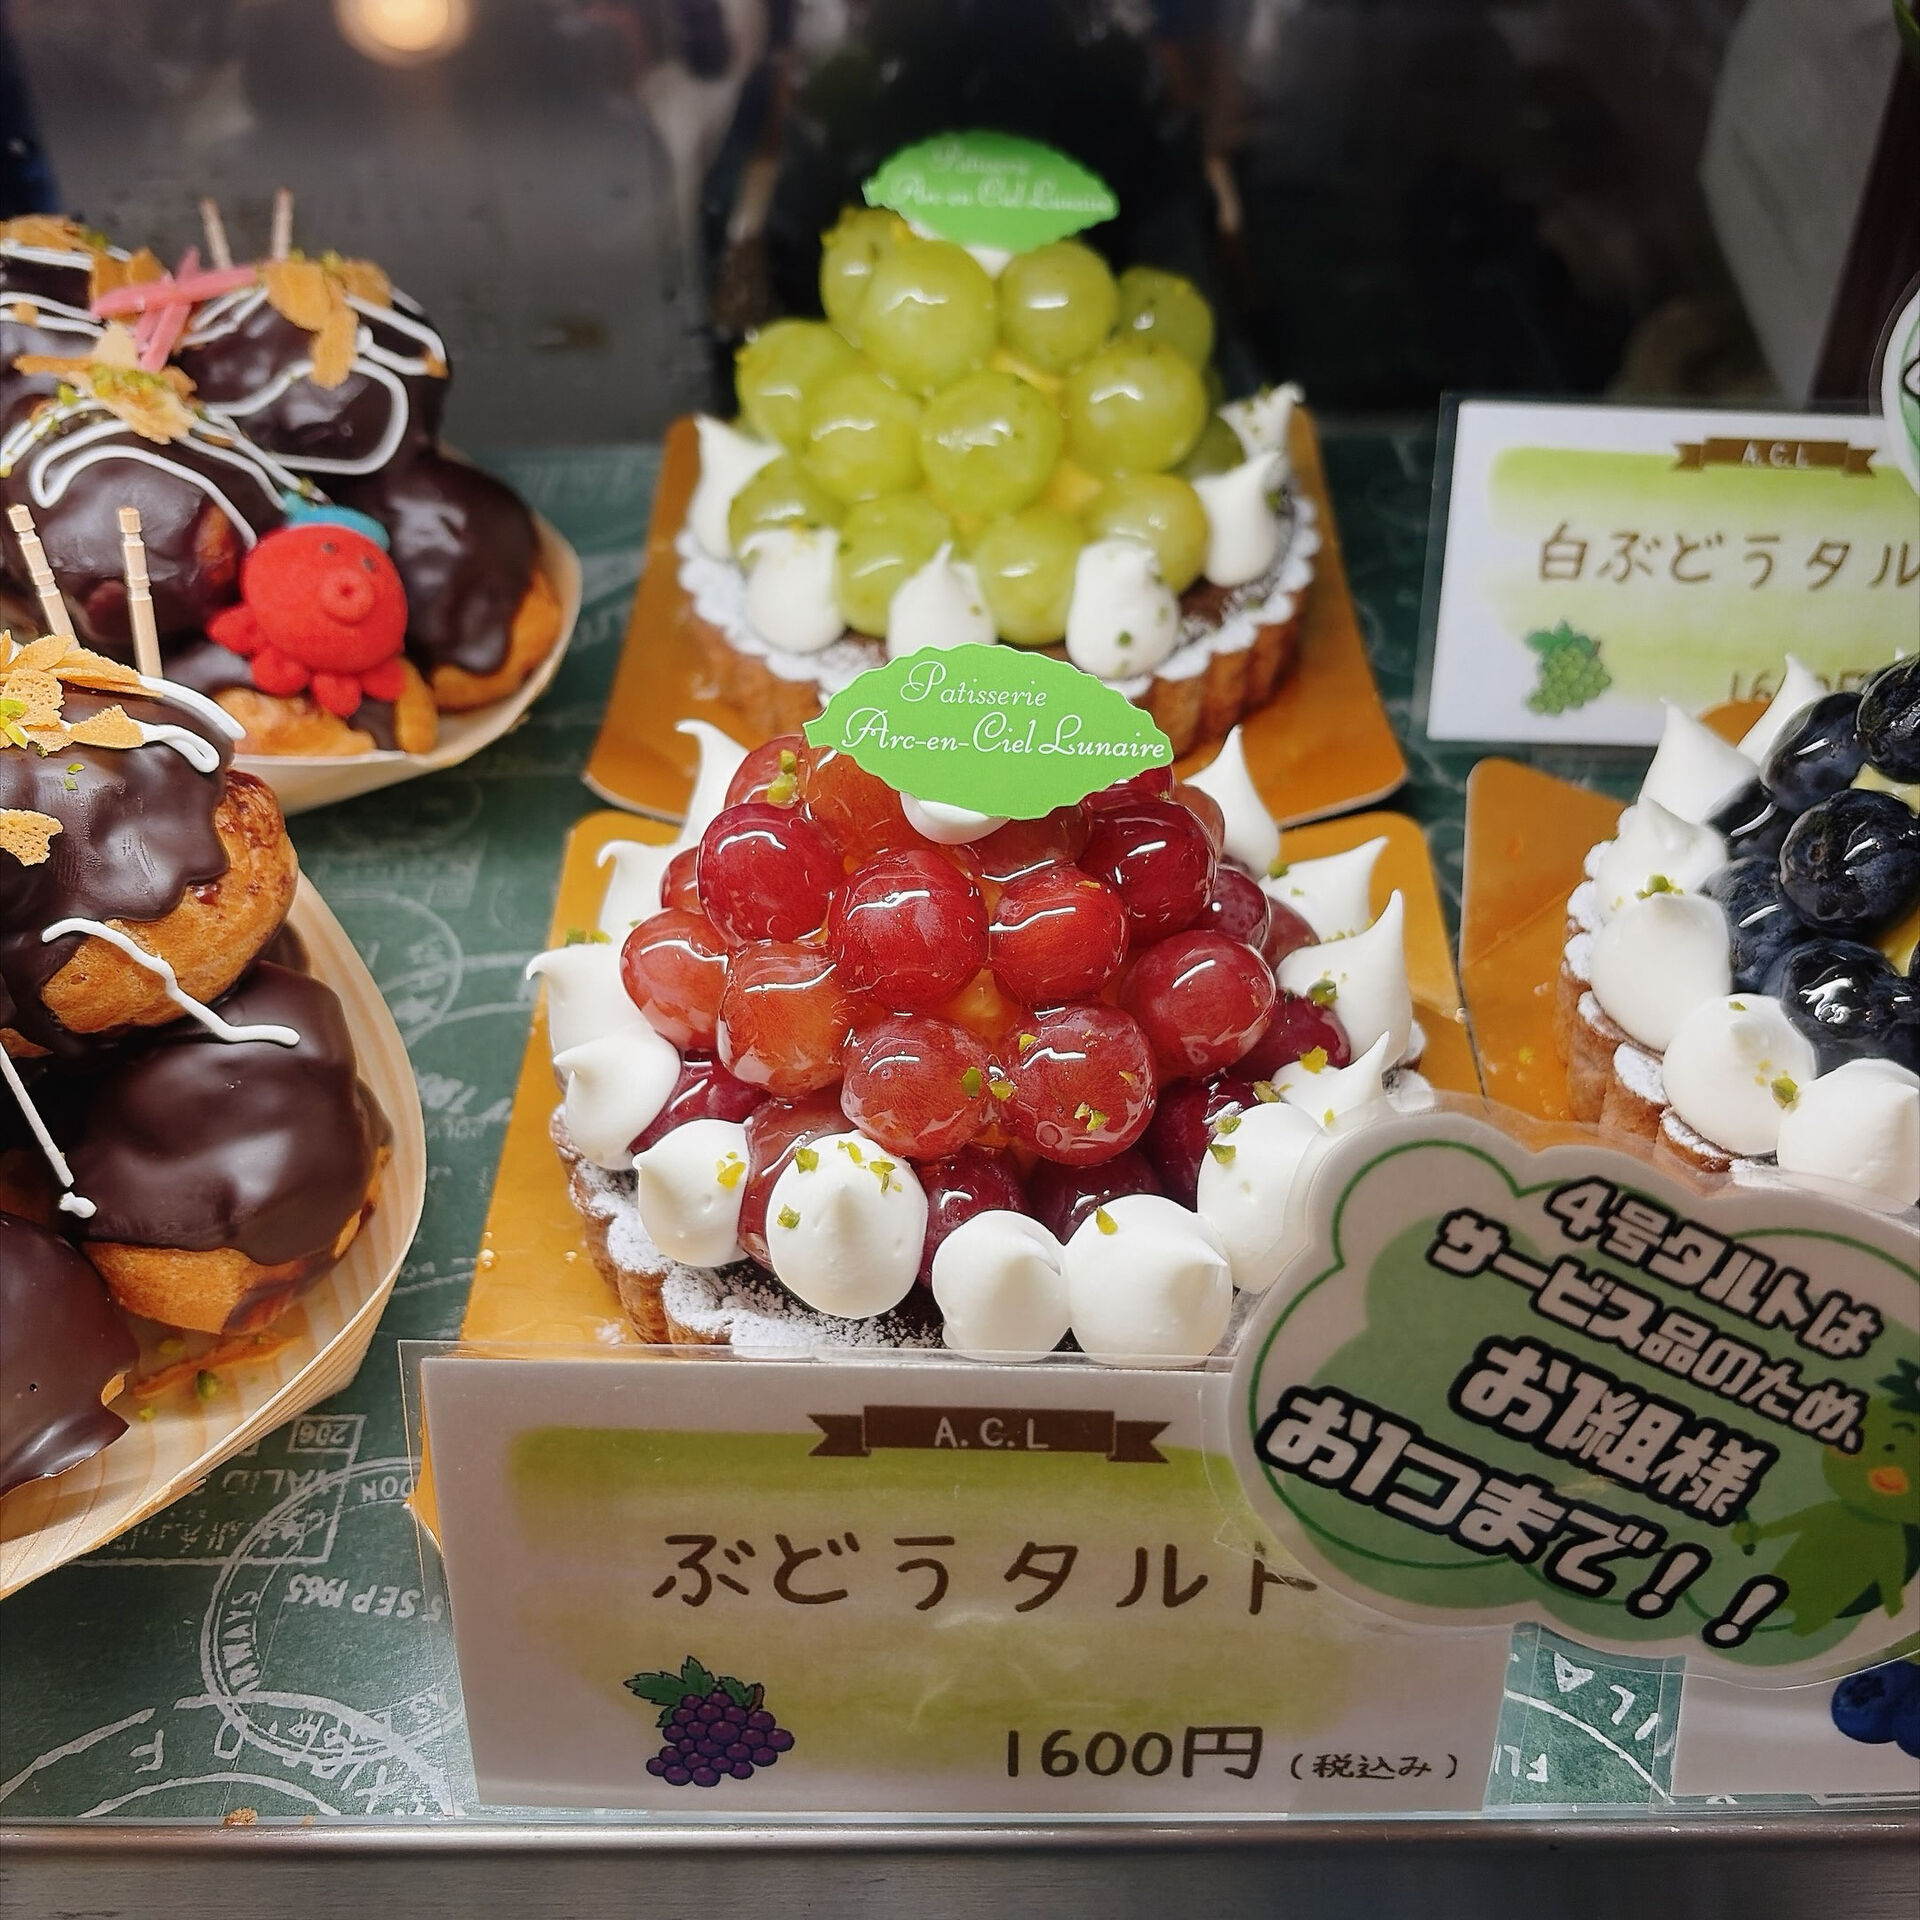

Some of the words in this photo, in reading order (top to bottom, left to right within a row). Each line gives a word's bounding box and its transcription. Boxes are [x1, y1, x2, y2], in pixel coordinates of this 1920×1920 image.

[901, 661, 1047, 706] Patisserie
[842, 707, 1036, 754] Arc-en-Ciel
[1038, 715, 1165, 759] Lunaire
[1548, 1178, 1882, 1358] 4号タルトは
[1430, 1210, 1868, 1453] サービス品のため、
[1452, 1338, 1778, 1524] お1組様
[352, 1584, 421, 1619] SEP
[652, 1531, 1318, 1615] ぶどうタルト
[1006, 1727, 1263, 1779] 1600円
